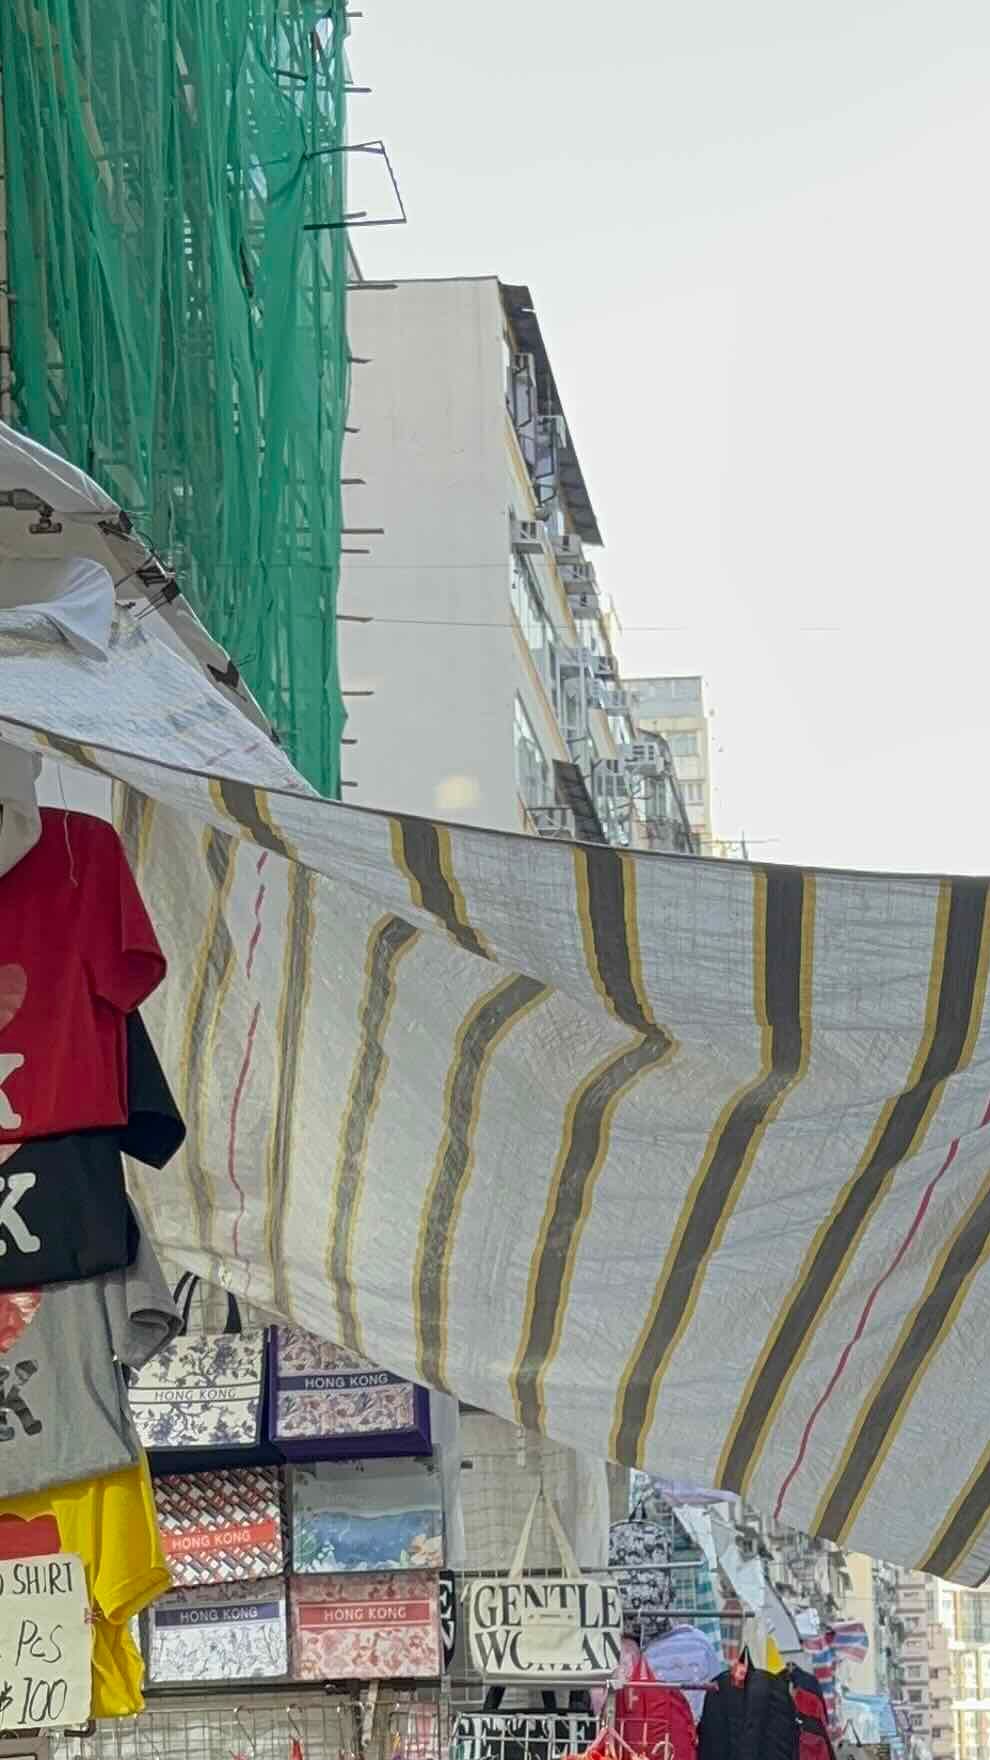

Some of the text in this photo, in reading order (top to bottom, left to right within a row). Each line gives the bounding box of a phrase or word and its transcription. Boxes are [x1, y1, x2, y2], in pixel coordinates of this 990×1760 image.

[305, 1374, 388, 1389] HONG KONG
[155, 1388, 236, 1401] HONG KONG
[172, 1530, 251, 1550] HONG KONG
[12, 1562, 73, 1595] SHIRT
[180, 1606, 258, 1624] HONG KONG
[323, 1606, 407, 1621] HONG KONG
[473, 1583, 622, 1629] GENTLE
[474, 1629, 622, 1671] WOAN
